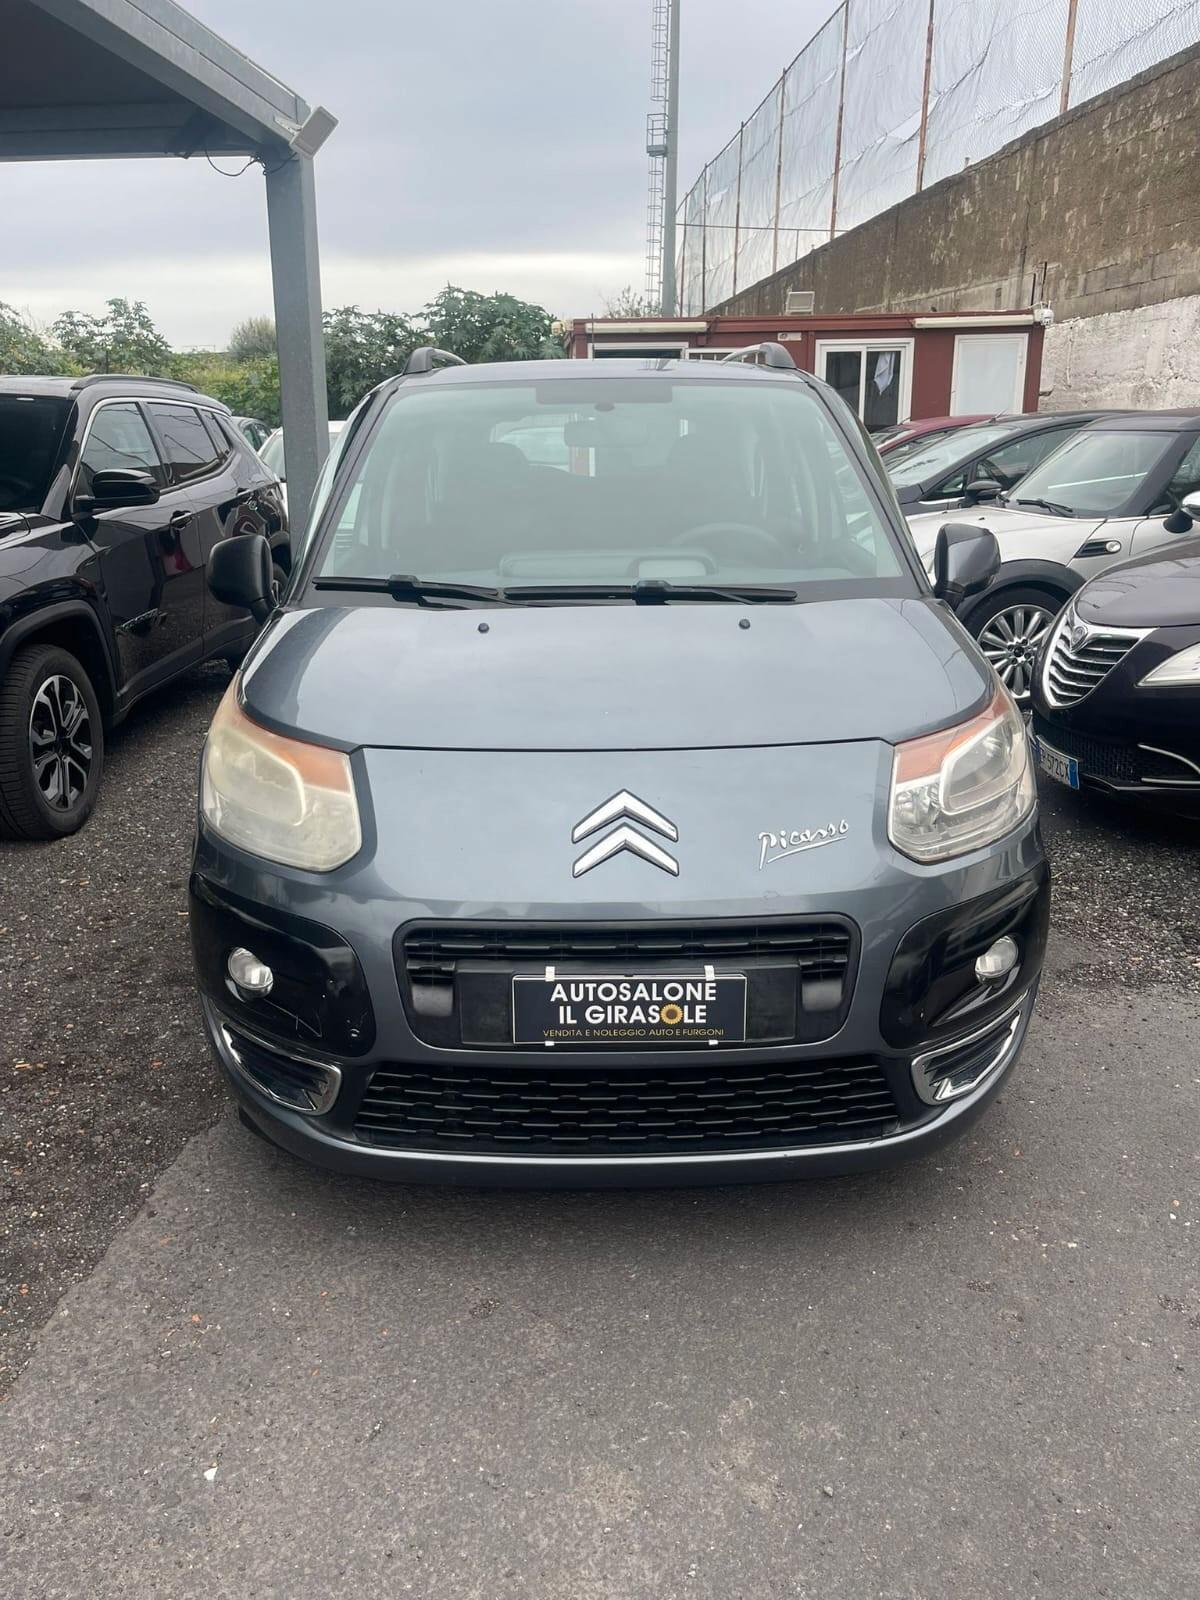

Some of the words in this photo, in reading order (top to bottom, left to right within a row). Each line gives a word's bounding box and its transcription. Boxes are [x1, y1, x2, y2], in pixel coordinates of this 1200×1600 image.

[758, 819, 849, 870] Picasso
[550, 983, 717, 1002] AUTOSALONE
[559, 1005, 577, 1024] IL
[585, 1004, 707, 1025] GIRASOLE
[543, 1029, 583, 1037] VENDITA
[585, 1029, 591, 1037] E
[593, 1028, 646, 1037] NOLEGGIO
[649, 1028, 674, 1037] AUTO
[675, 1028, 681, 1036] E
[682, 1028, 724, 1036] FURGONI
